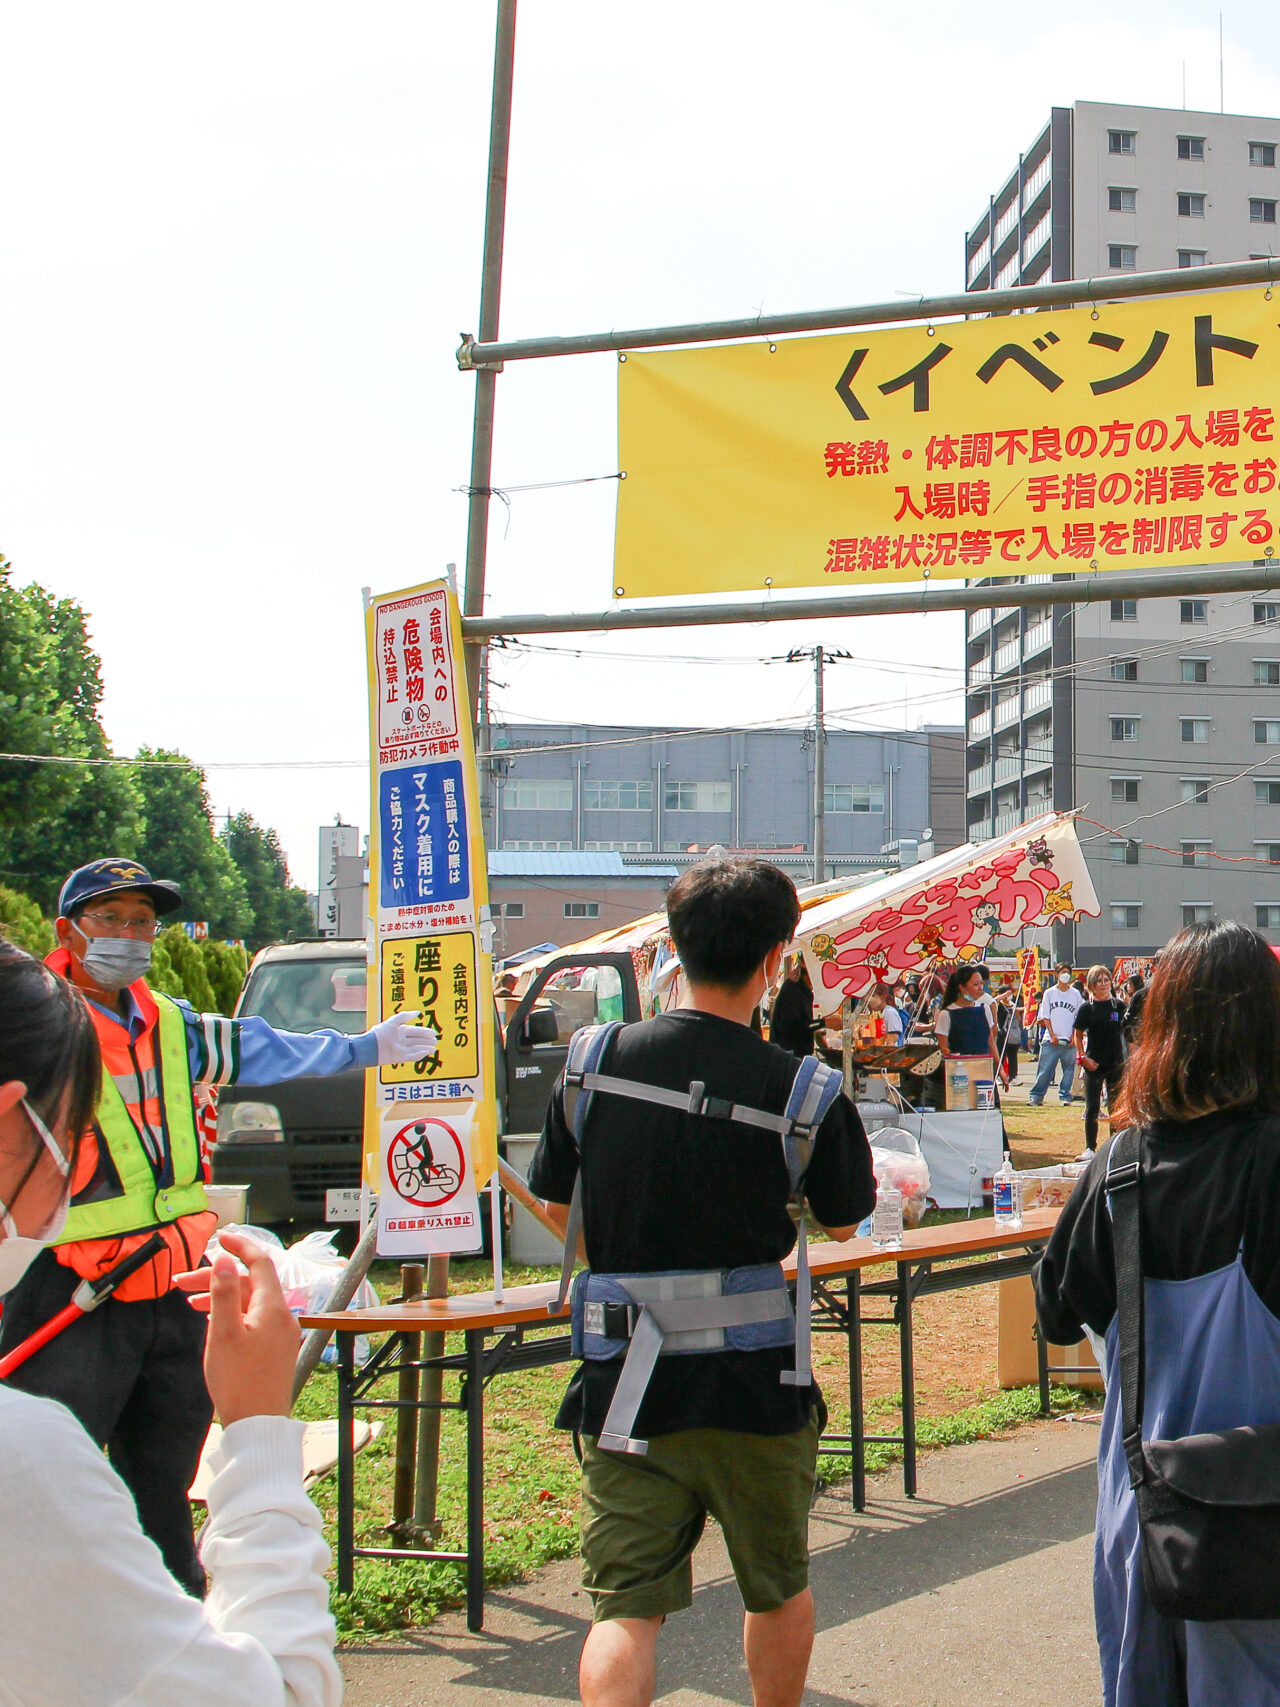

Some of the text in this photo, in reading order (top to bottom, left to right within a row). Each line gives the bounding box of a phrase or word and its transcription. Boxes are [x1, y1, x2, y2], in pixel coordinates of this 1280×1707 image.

[380, 594, 443, 614] NO DANGEROUS GOODS
[383, 628, 398, 704] 持込禁止
[402, 618, 425, 703] 危険物
[429, 607, 448, 702] 会場内への
[380, 739, 459, 764] 防犯カメラ作動中
[390, 787, 404, 890] ご協力ください
[412, 773, 433, 897] マスク着用に
[442, 777, 460, 884] 商品購入の際は
[398, 903, 455, 917] 熱中症対策のため
[453, 963, 469, 1048] 会場内での
[384, 1083, 474, 1101] ゴミはゴミ箱へ
